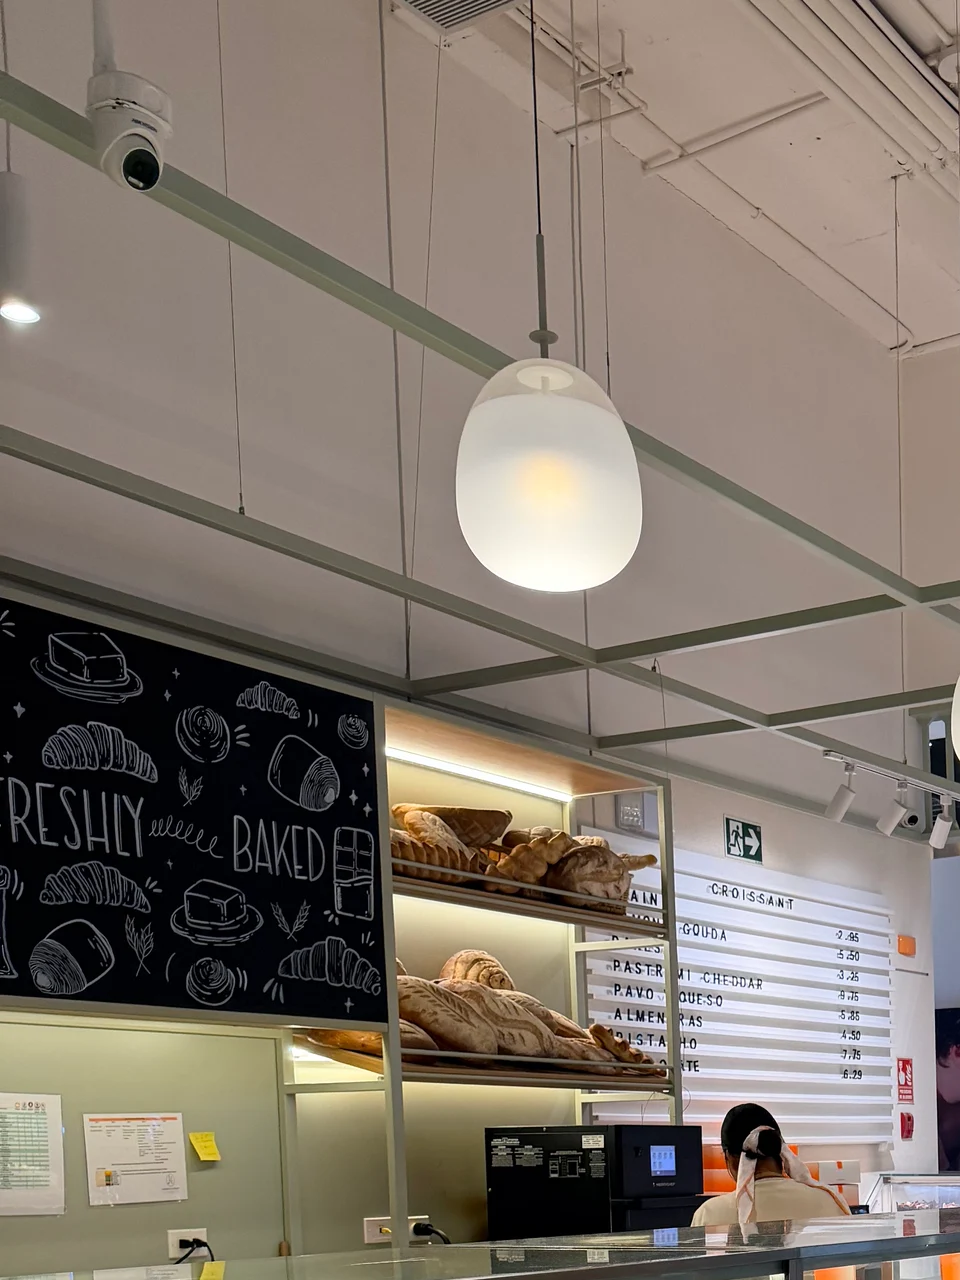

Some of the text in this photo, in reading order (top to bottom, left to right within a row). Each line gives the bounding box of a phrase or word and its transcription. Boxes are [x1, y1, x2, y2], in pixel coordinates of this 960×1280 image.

[0, 776, 326, 882] RESHLY BAKED
[711, 882, 794, 910] CROISSANT
[682, 922, 727, 941] GOUDA
[613, 959, 691, 981] PASTRMI
[703, 971, 763, 990] CHEDDAR
[614, 983, 654, 1000] PAVO
[679, 991, 723, 1007] QUESO
[614, 1008, 703, 1027] ALMENRAS
[616, 1031, 697, 1049] PISTAHO
